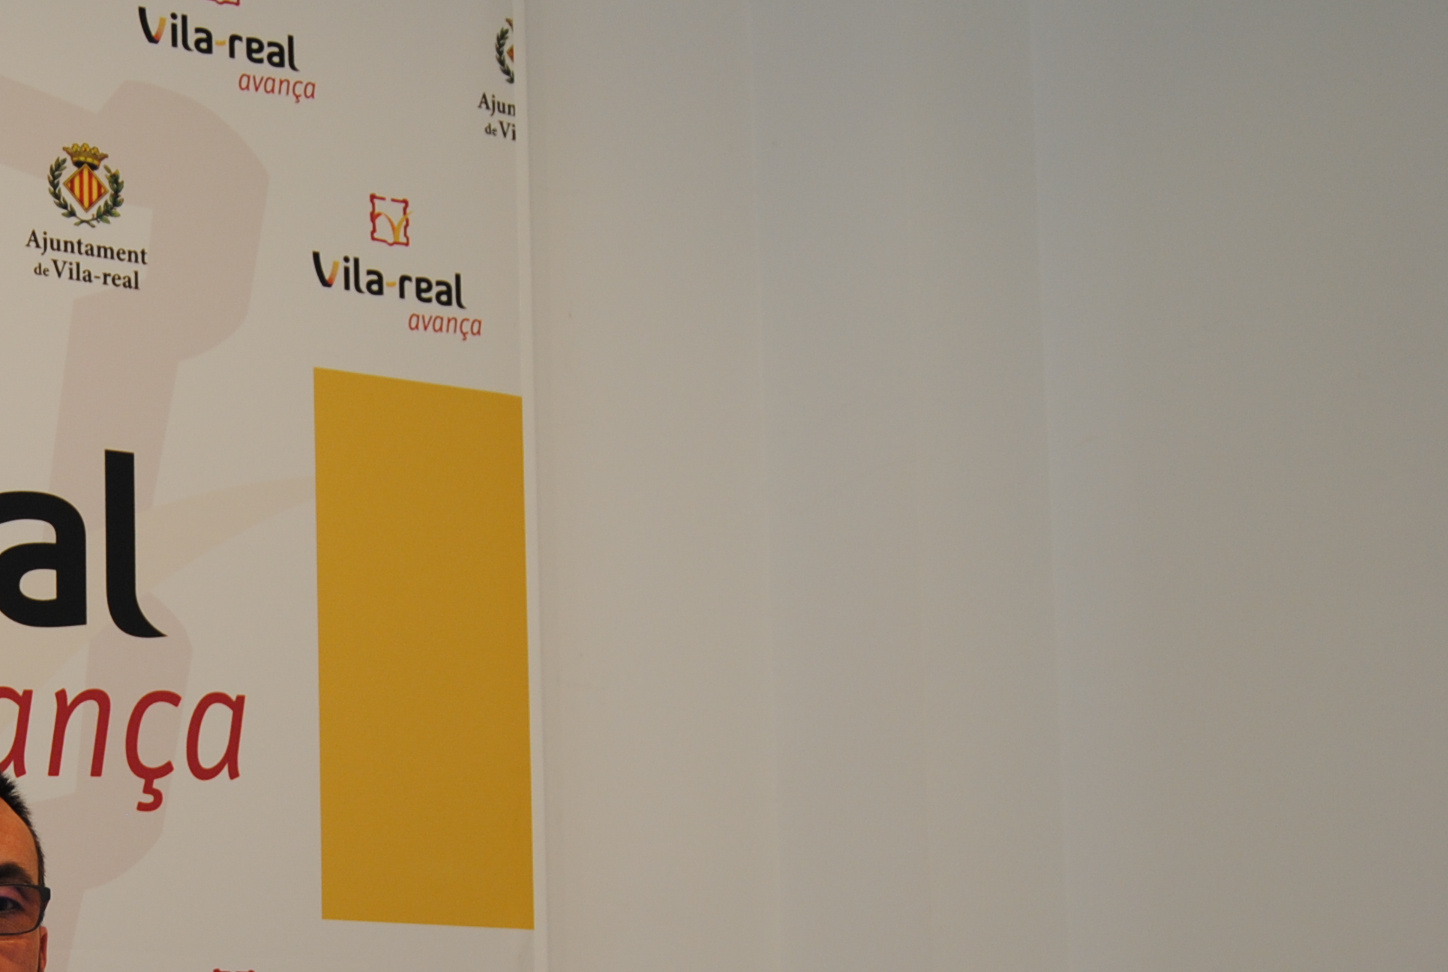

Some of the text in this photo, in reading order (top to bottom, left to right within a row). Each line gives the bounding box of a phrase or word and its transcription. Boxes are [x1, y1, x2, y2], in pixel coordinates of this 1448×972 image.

[138, 6, 299, 71] Vila-real
[239, 72, 316, 103] avança
[485, 123, 497, 136] de
[25, 229, 148, 264] Ajuntament
[34, 259, 140, 290] de Vila-real
[313, 251, 465, 309] Vila-real
[408, 311, 483, 341] avança
